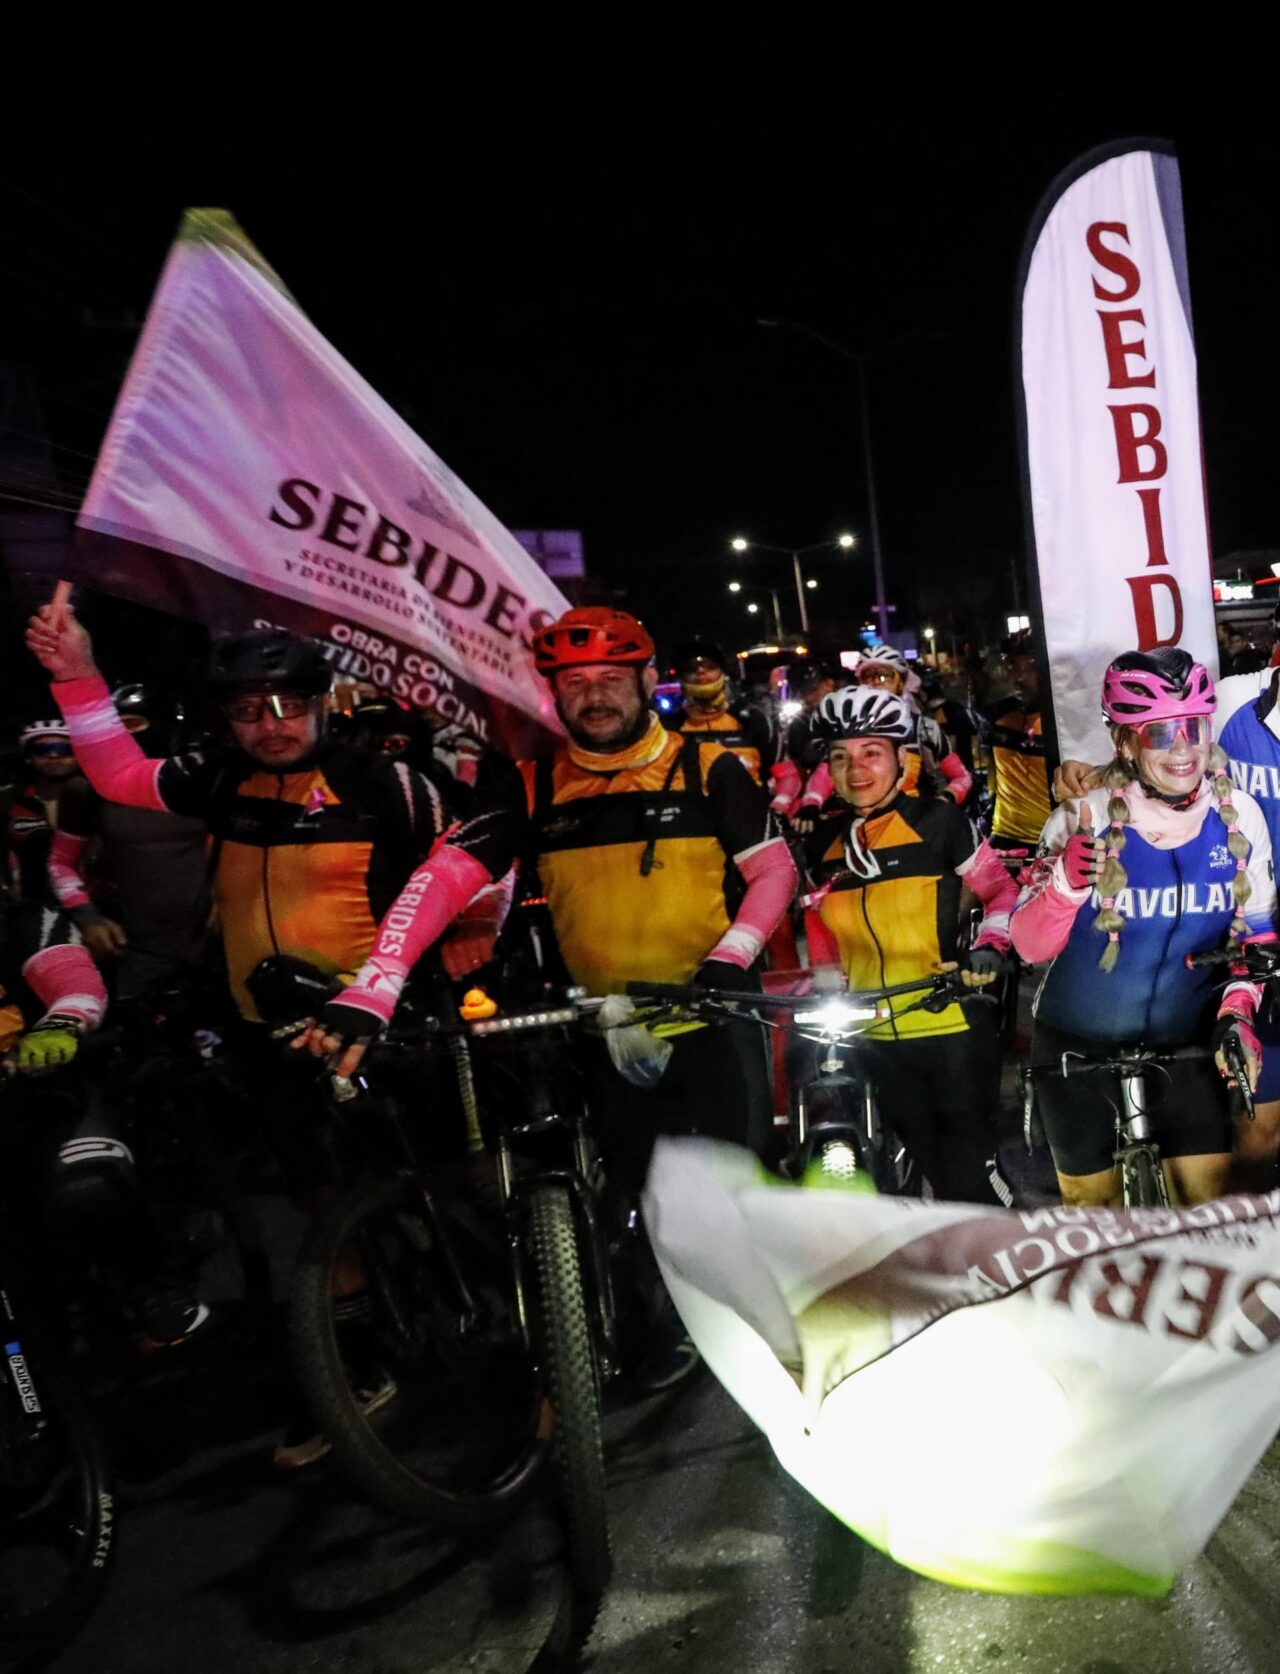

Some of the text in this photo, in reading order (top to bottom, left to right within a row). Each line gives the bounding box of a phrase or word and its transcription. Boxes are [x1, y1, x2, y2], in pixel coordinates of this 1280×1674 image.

[300, 566, 414, 619] DESARROLLO
[330, 623, 455, 691] OBRA CON
[392, 676, 488, 741] SOCIAL
[378, 871, 433, 956] SEBIDES
[91, 1492, 113, 1569] MAXXIS
